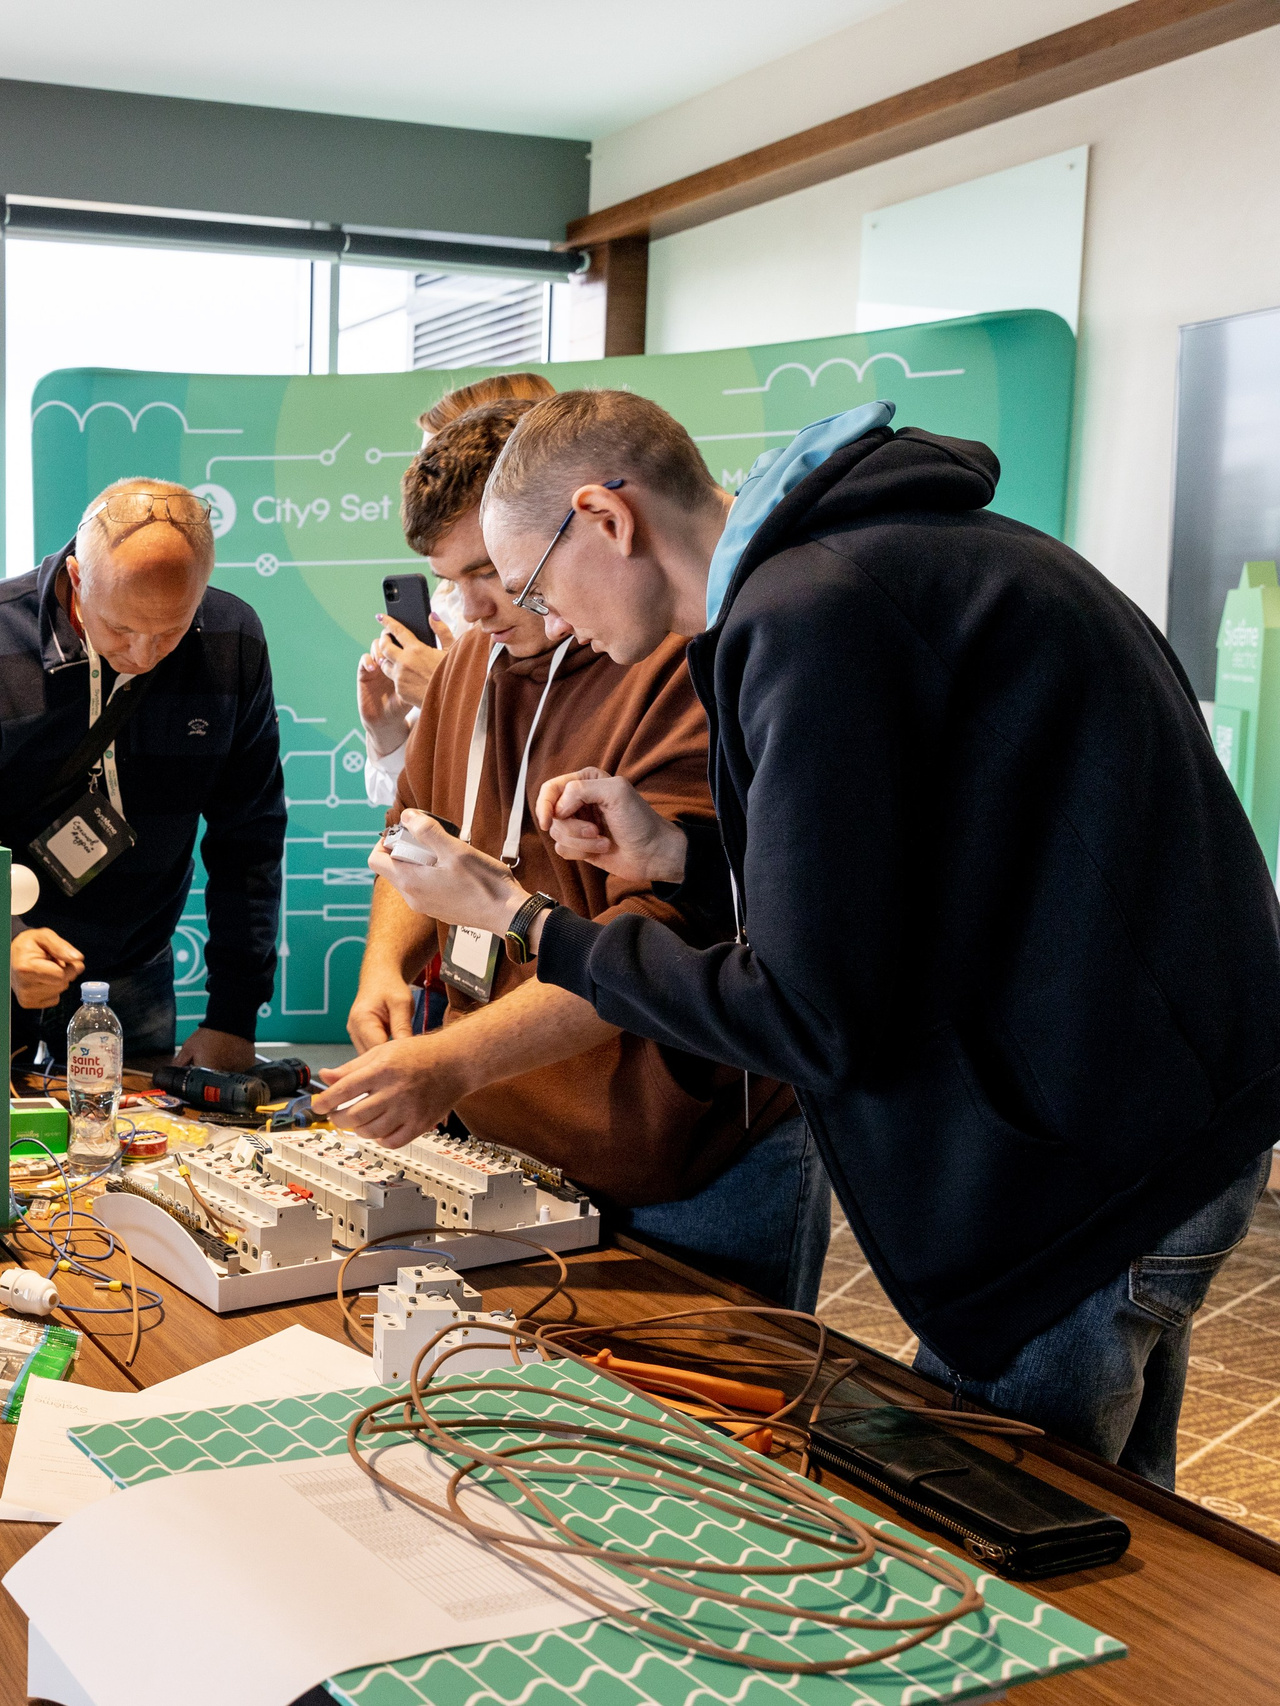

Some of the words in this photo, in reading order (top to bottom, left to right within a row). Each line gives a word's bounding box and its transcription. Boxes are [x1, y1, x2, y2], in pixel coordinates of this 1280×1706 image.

[252, 495, 330, 529] City9
[339, 493, 392, 522] Set
[72, 1055, 101, 1066] saint
[70, 1064, 104, 1079] spring
